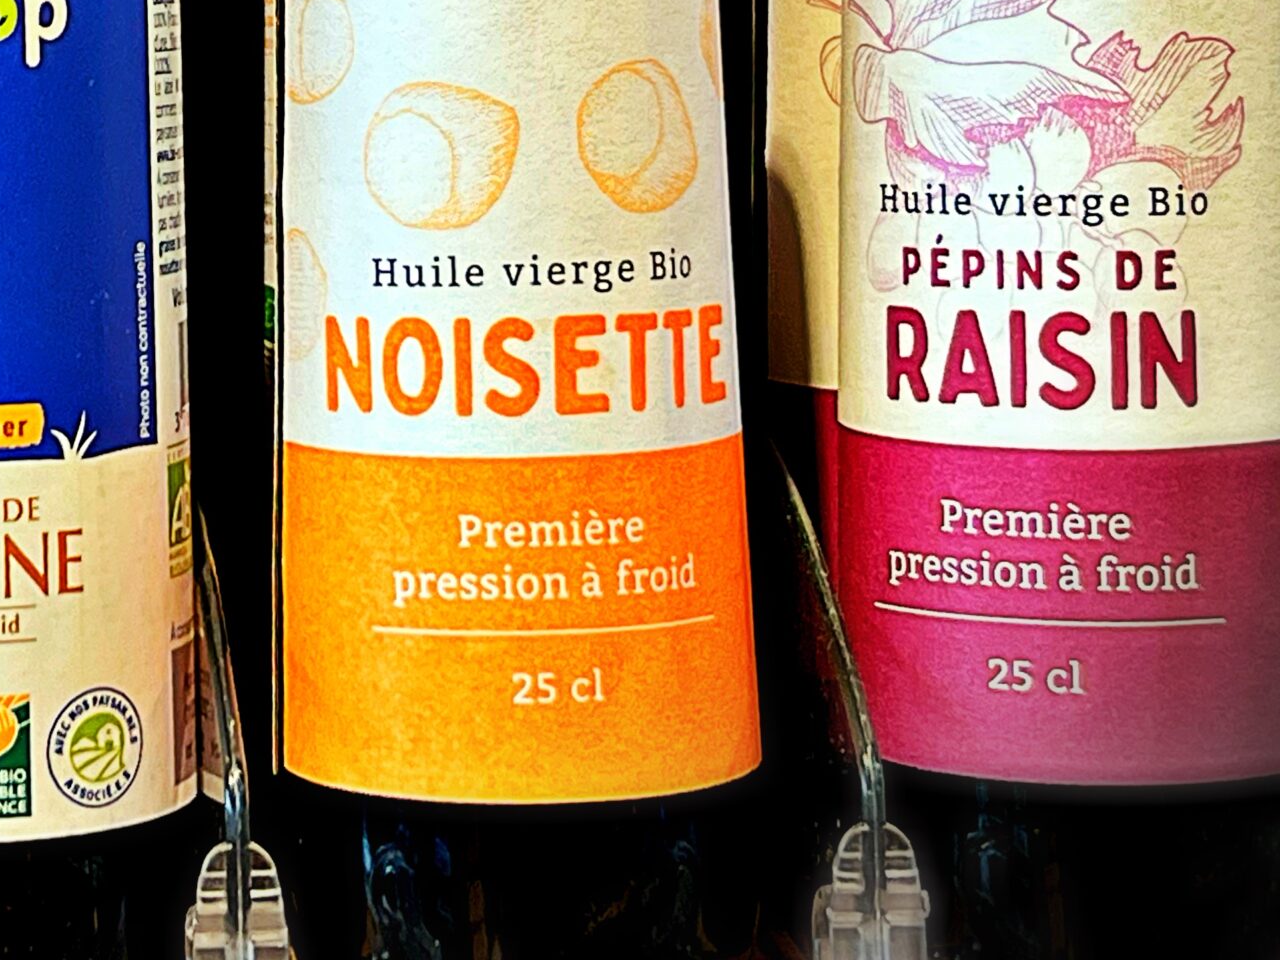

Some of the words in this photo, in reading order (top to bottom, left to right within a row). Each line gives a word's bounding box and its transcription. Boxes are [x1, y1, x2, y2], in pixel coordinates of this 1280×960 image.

[879, 183, 972, 216] Huile
[989, 187, 1130, 226] vierge
[1148, 184, 1209, 216] Bio
[372, 255, 484, 289] Huile
[503, 253, 635, 294] vierge
[650, 247, 692, 282] Bio
[902, 234, 1081, 291] PÉPINS
[1116, 249, 1177, 290] DE
[134, 241, 149, 352] contractuelle
[140, 354, 149, 387] non
[325, 303, 727, 417] NOISETTE
[886, 305, 1198, 411] RAISIN
[140, 389, 150, 439] Photo
[3, 496, 40, 523] DE
[458, 509, 644, 548] Première
[940, 498, 1131, 541] Première
[393, 563, 569, 608] pression
[582, 562, 603, 597] à
[616, 553, 696, 596] froid
[889, 549, 1047, 591] pression
[1058, 554, 1083, 592] à
[1097, 553, 1199, 593] froid
[512, 671, 556, 705] 25
[571, 667, 605, 702] cl
[987, 658, 1032, 692] 25
[1046, 660, 1085, 695] cl
[55, 721, 71, 755] AVEC
[70, 700, 90, 722] NOS
[0, 768, 27, 784] BIO
